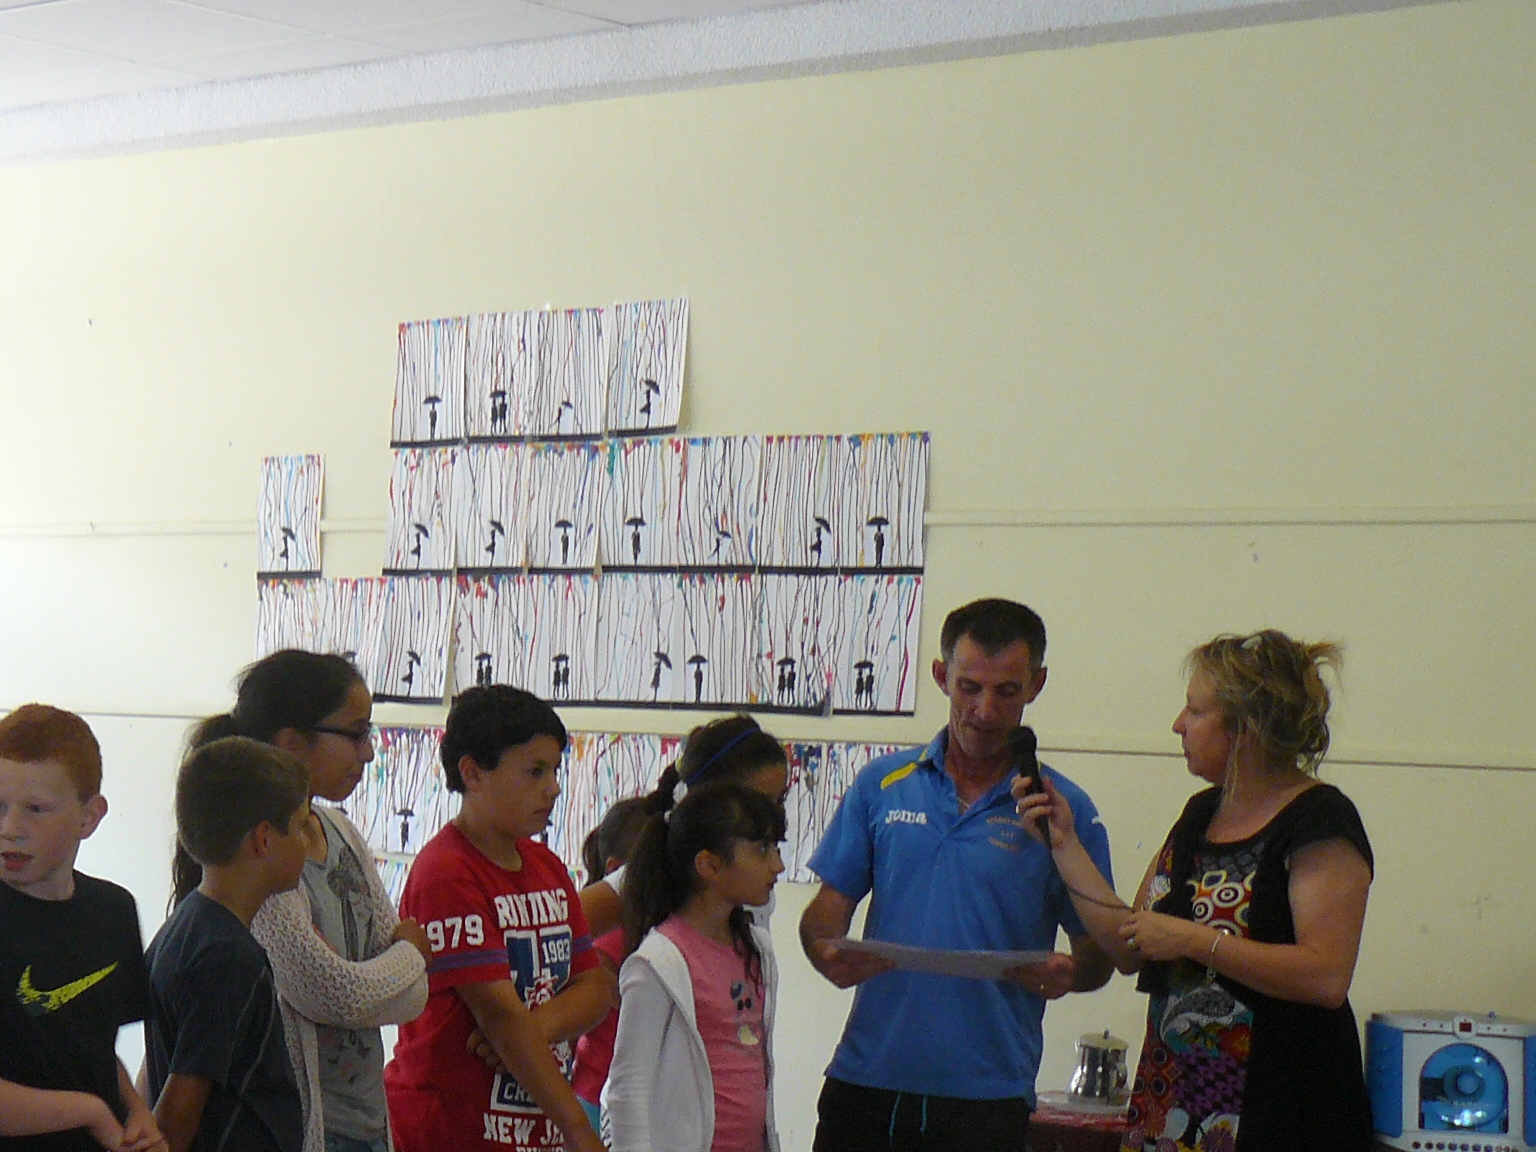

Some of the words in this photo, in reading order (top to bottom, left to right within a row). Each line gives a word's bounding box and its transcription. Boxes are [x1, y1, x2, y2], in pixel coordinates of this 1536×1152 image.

[420, 913, 485, 953] 979
[541, 938, 571, 966] 1983
[482, 1113, 537, 1146] NEW
